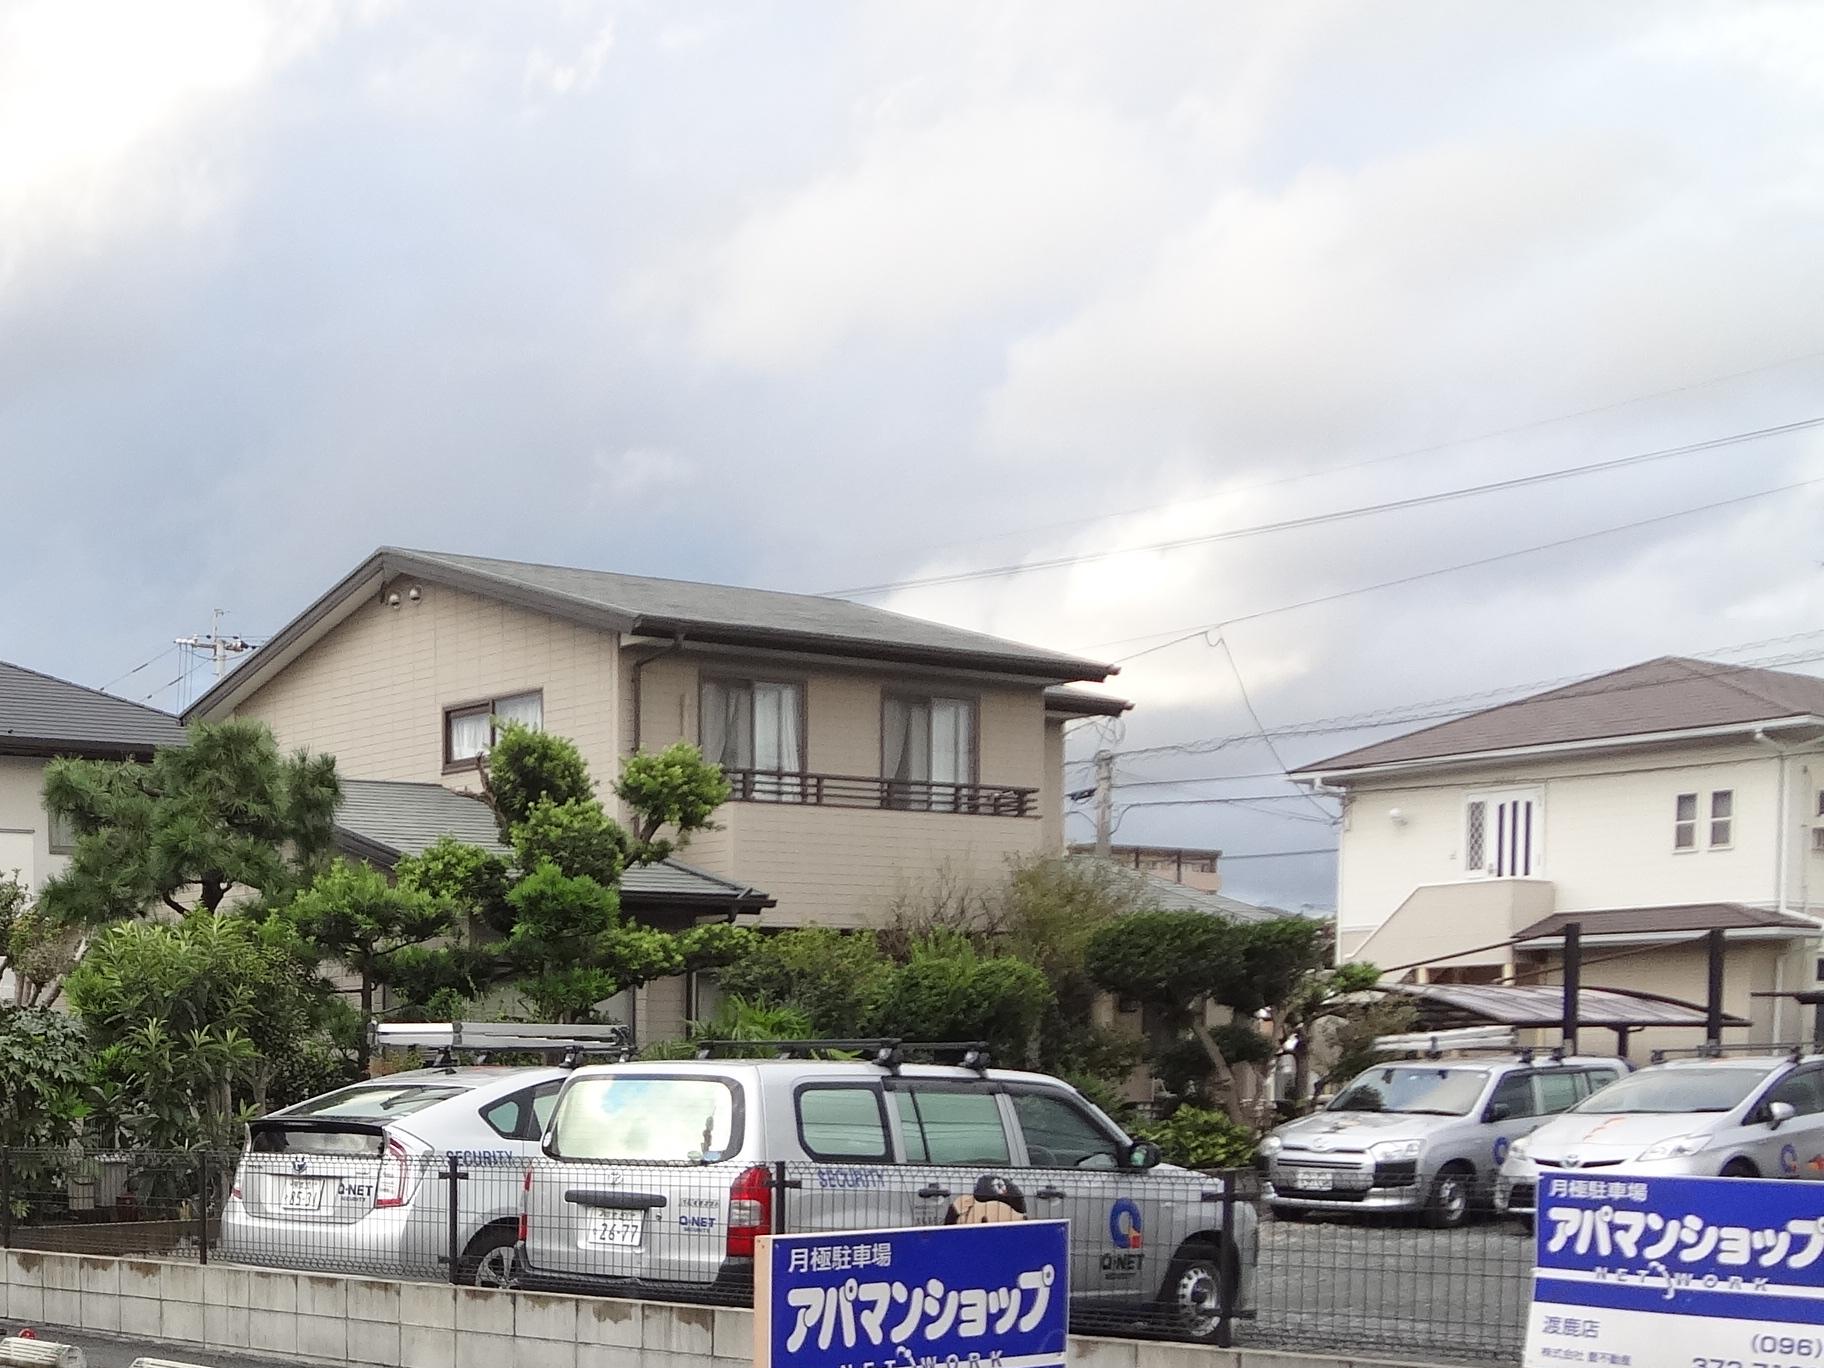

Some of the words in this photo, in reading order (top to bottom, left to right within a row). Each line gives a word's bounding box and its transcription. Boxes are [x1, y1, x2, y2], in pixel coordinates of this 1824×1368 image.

[818, 1168, 885, 1187] SECURITY
[1549, 1179, 1648, 1201] 月極駐車場
[1547, 1205, 1824, 1269] アパマンショップ
[788, 1243, 892, 1273] 月極駐車場
[787, 1264, 1055, 1353] アパマンショップ
[1542, 1315, 1601, 1338] 渡鹿店
[1752, 1333, 1822, 1359] (096)
